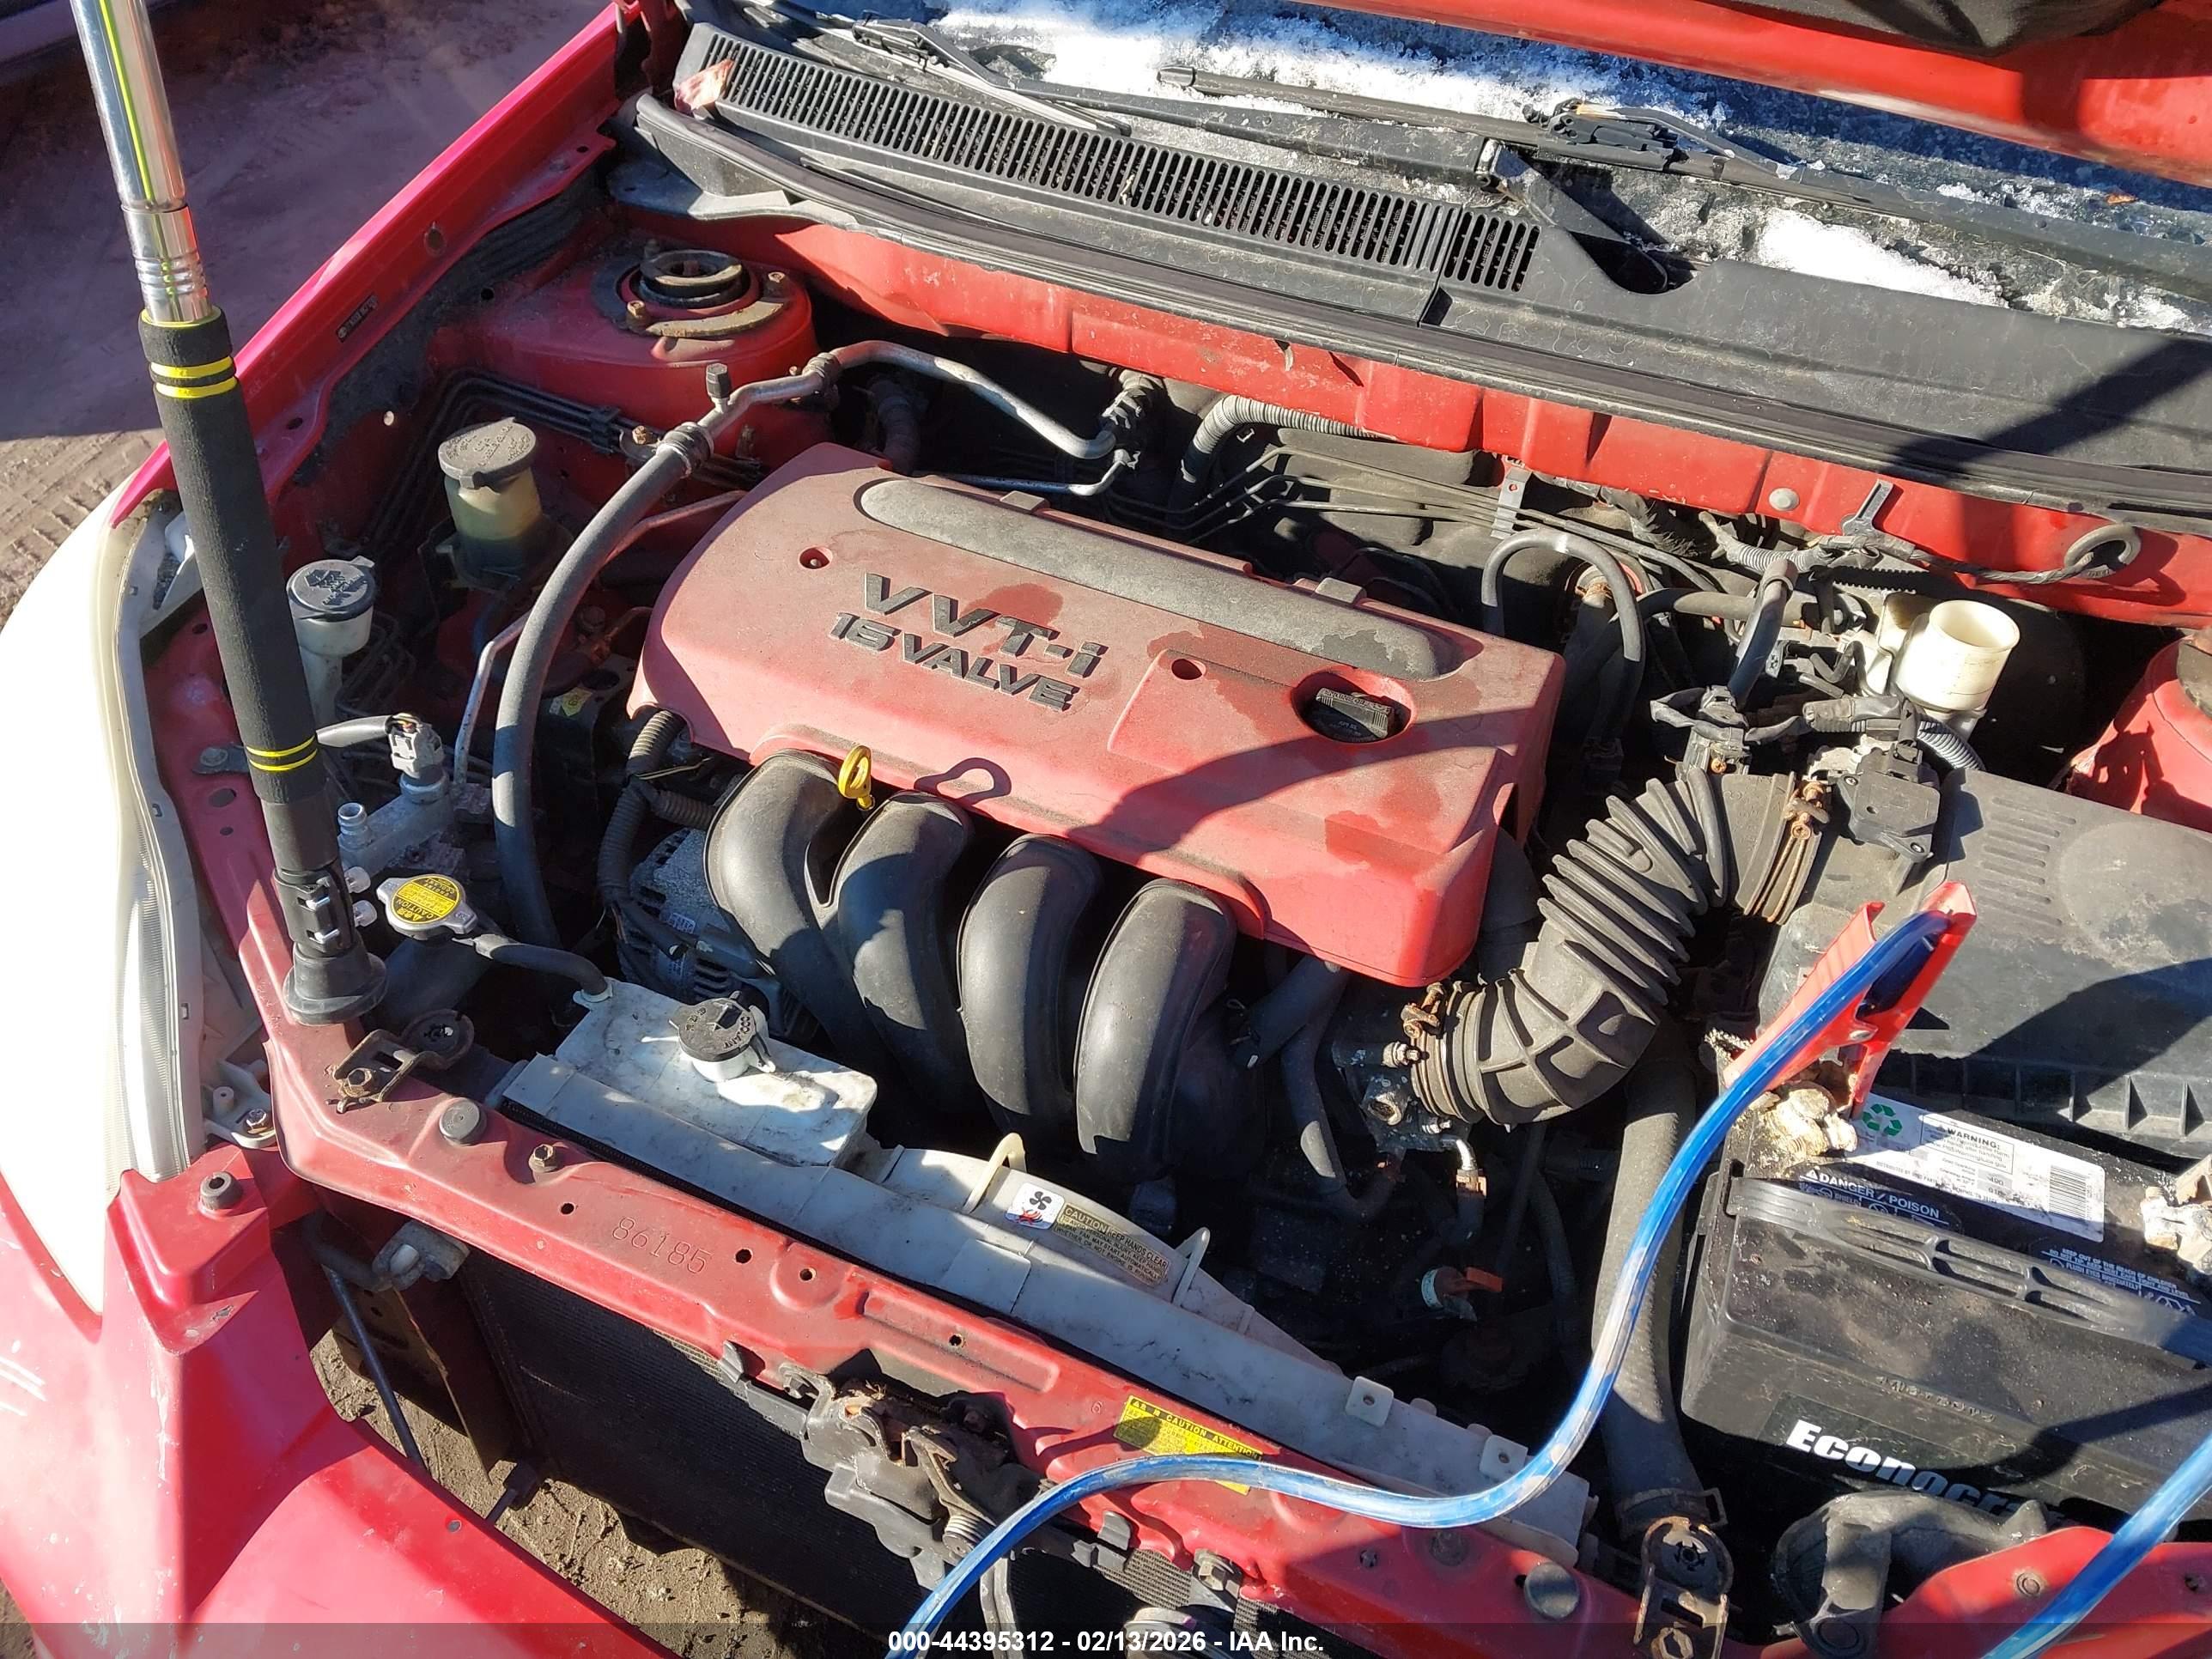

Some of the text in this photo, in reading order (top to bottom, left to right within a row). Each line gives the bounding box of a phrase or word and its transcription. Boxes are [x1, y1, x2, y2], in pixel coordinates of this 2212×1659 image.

[864, 572, 1109, 678] VVT-i
[395, 898, 434, 919] CAUTION
[723, 1016, 750, 1049] COOLANT
[1947, 1127, 2002, 1150] WARNING:
[1818, 1172, 1875, 1200] DANGER
[1889, 1194, 1939, 1218] POISON
[611, 1216, 714, 1274] 86185
[1064, 1206, 1108, 1234] CAUTION
[1124, 1238, 1147, 1256] HANDS
[1146, 1251, 1168, 1269] CLEAR
[1165, 1413, 1207, 1437] CAUTION
[1212, 1435, 1259, 1460] ATTENTION
